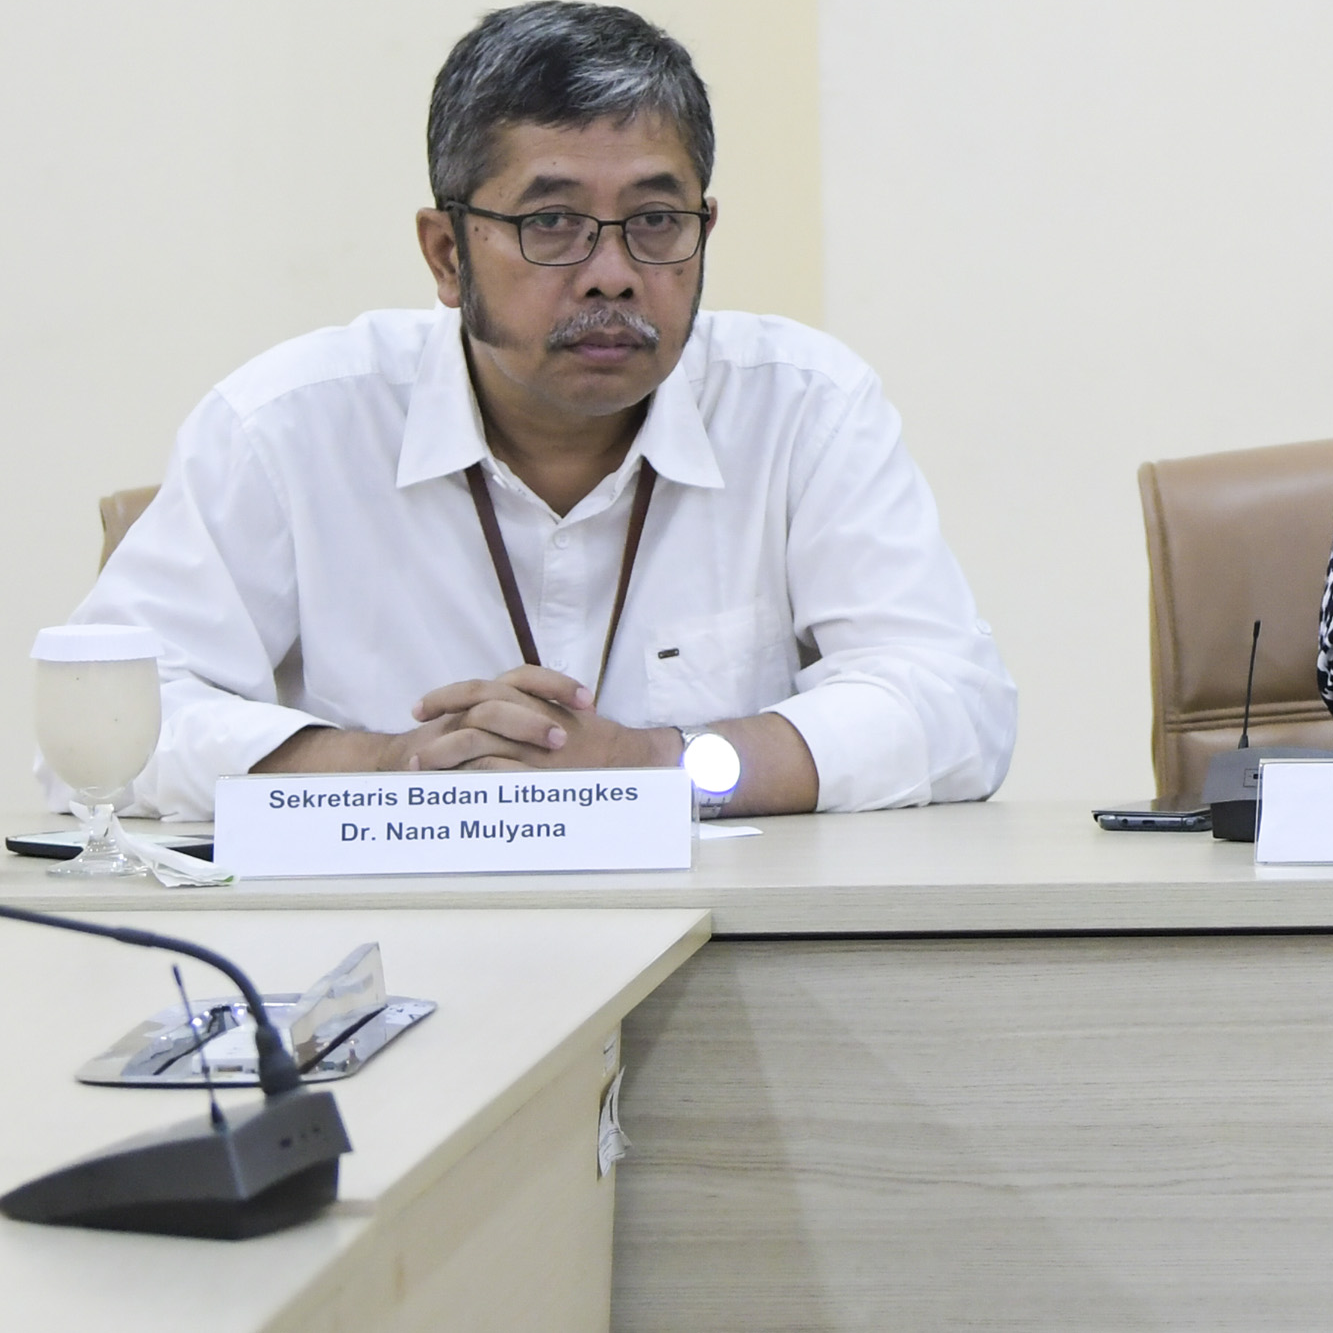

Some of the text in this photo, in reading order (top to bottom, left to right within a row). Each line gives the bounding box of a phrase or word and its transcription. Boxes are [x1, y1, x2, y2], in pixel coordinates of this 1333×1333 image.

[269, 783, 638, 808] Sekretaris Badan Litbangkes
[342, 820, 565, 843] Dr. Nana Mulyana
